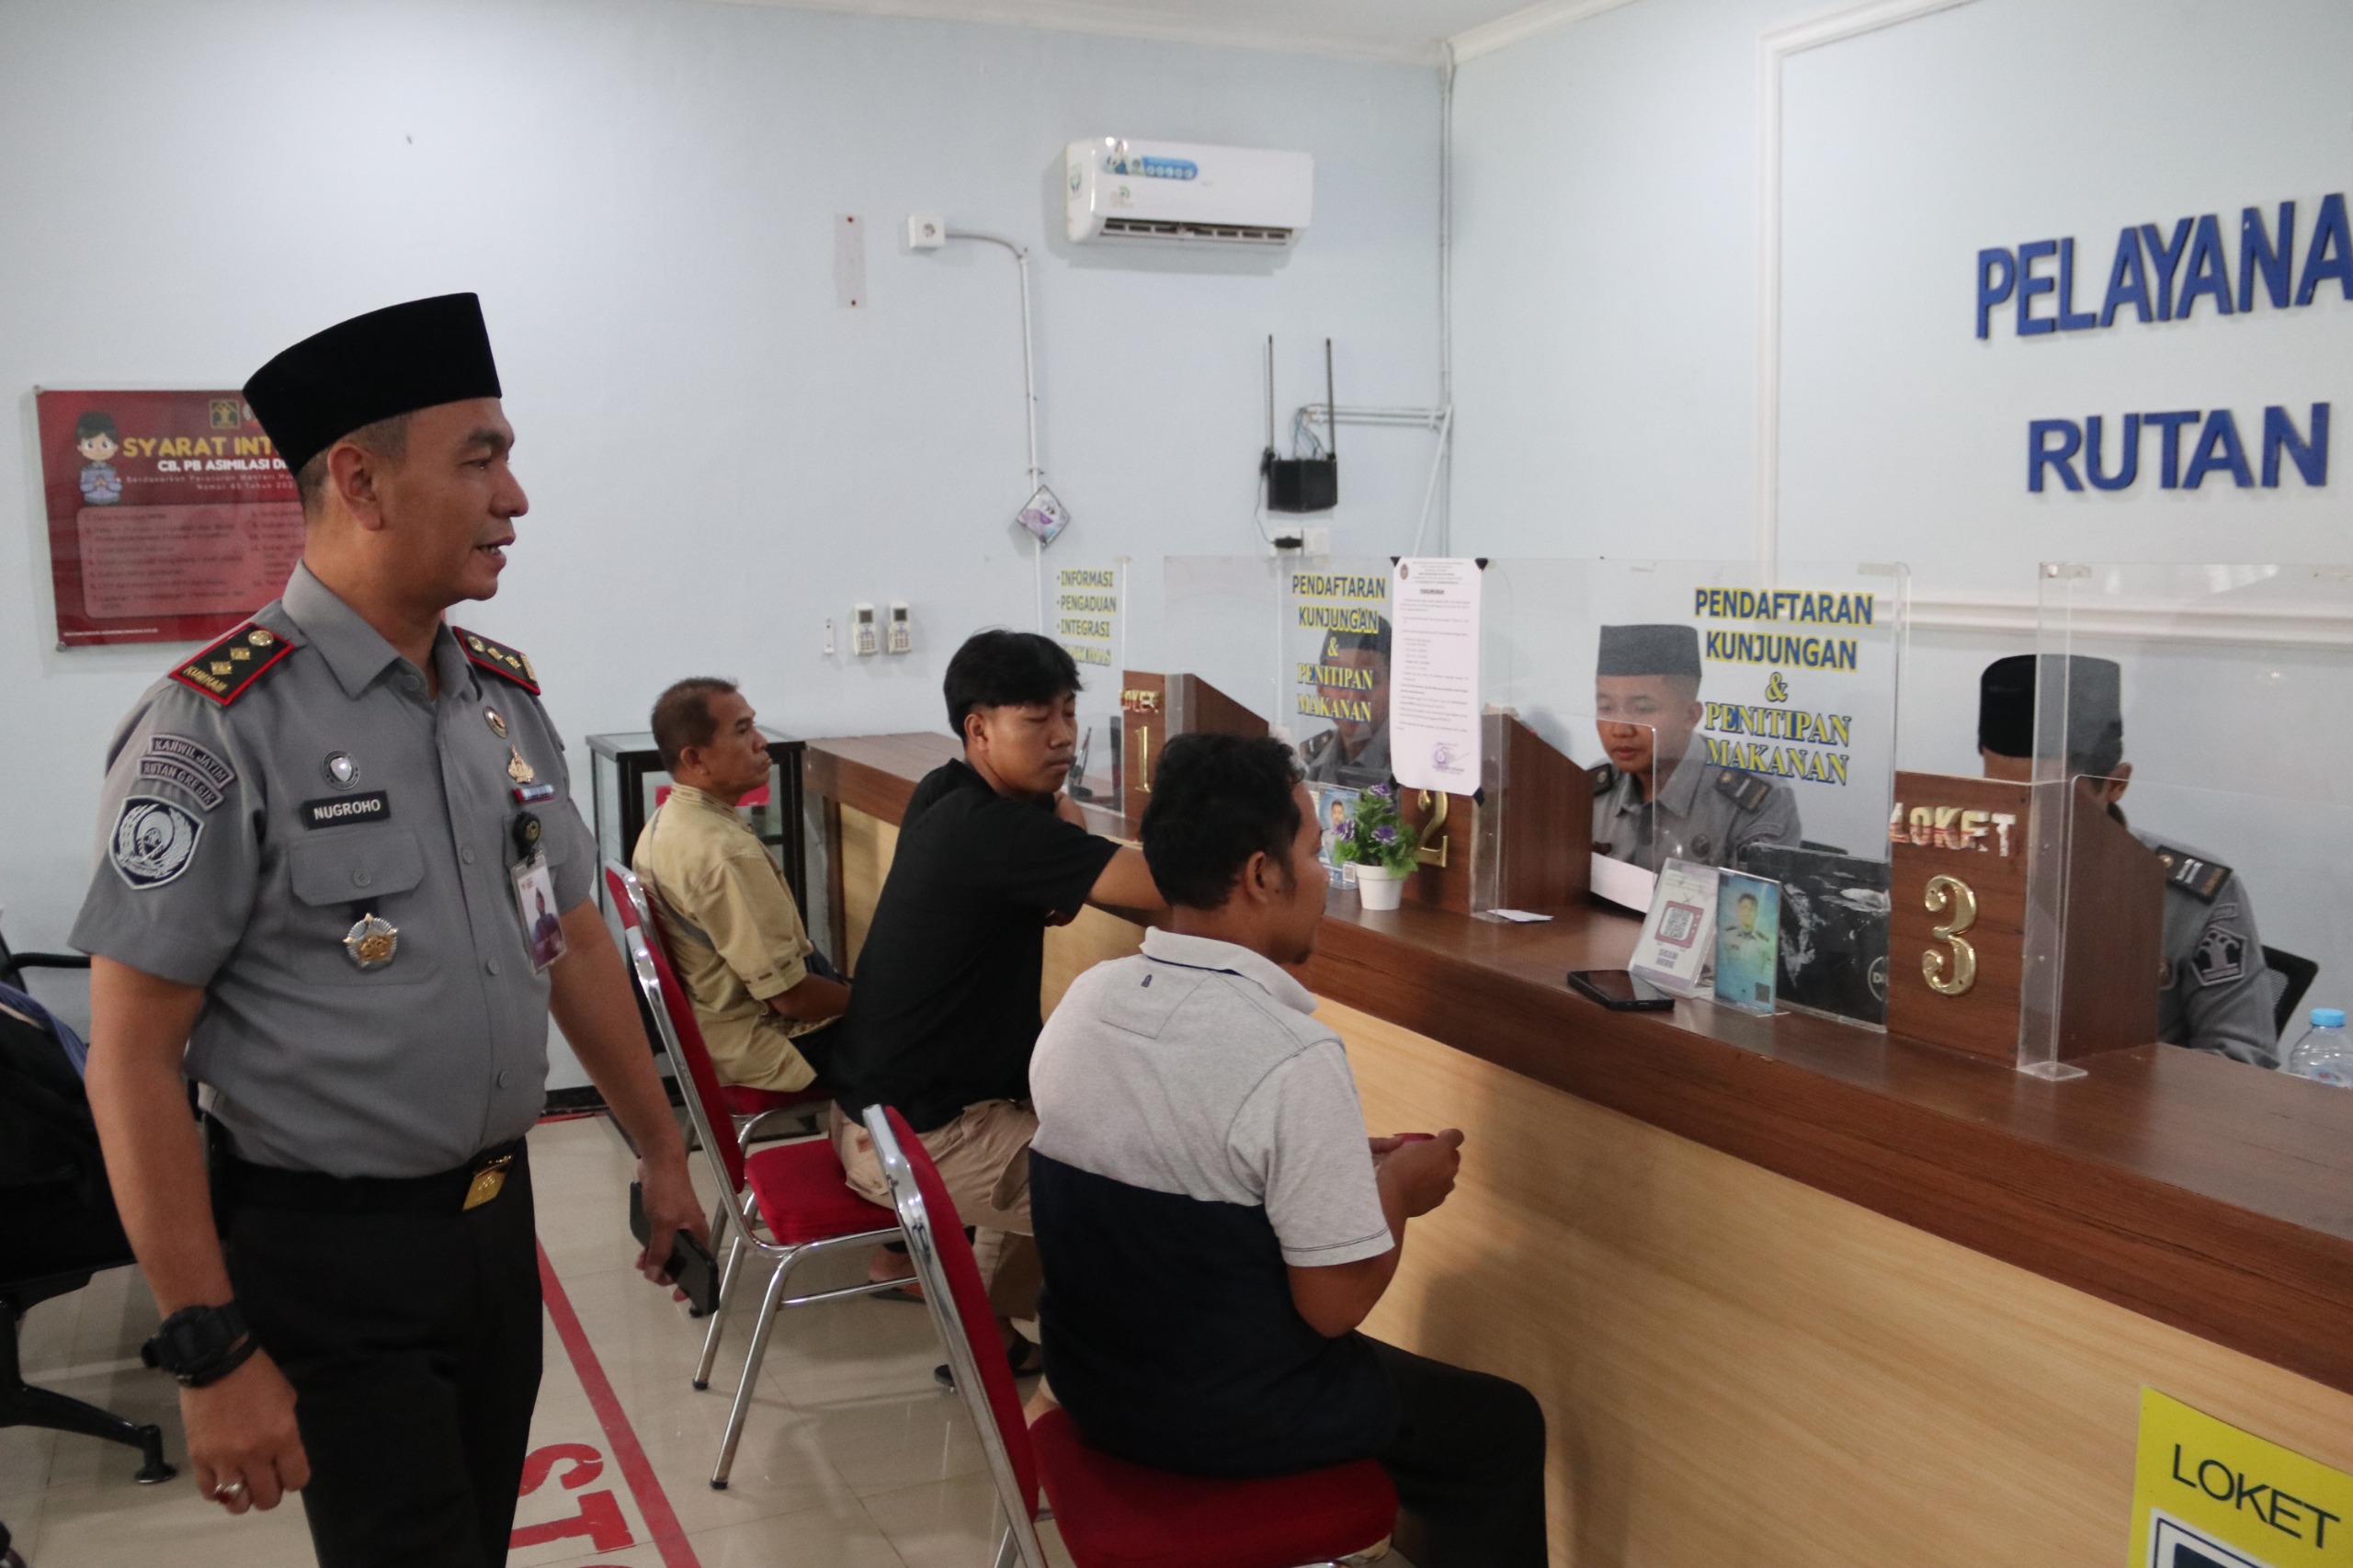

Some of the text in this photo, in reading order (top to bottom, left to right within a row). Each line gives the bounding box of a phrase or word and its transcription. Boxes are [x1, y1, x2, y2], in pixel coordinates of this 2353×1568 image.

[1975, 192, 2353, 340] PELAYANA
[123, 437, 278, 457] SYARAT INT
[2027, 402, 2331, 494] RUTAN
[185, 460, 202, 472] PB
[206, 459, 270, 471] ASIMILASI
[1061, 570, 1114, 587] INFORMASI
[1292, 574, 1387, 600] PENDAFTARAN
[1060, 594, 1117, 613] PENGADUAN
[1299, 606, 1380, 633] KUNJUNGAN
[1694, 587, 1874, 627] PENDAFTARAN
[1060, 619, 1110, 638] INTEGRASI
[1327, 636, 1339, 657] &
[1705, 630, 1859, 672] KUNJUNGAN
[1297, 663, 1373, 690] PENITIPAN
[1765, 672, 1788, 702] &
[1297, 694, 1371, 723] MAKANAN
[1705, 702, 1851, 747] PENITIPAN
[154, 740, 227, 781] KANWIL JATIM
[1705, 738, 1849, 786] MAKANAN
[143, 762, 216, 805] RUTAN GRESIK
[313, 799, 381, 820] NUGROHO
[1416, 790, 1449, 868] 2
[1889, 802, 2017, 858] LOKET
[1922, 874, 1977, 996] 3
[2172, 1443, 2341, 1549] LOKET
